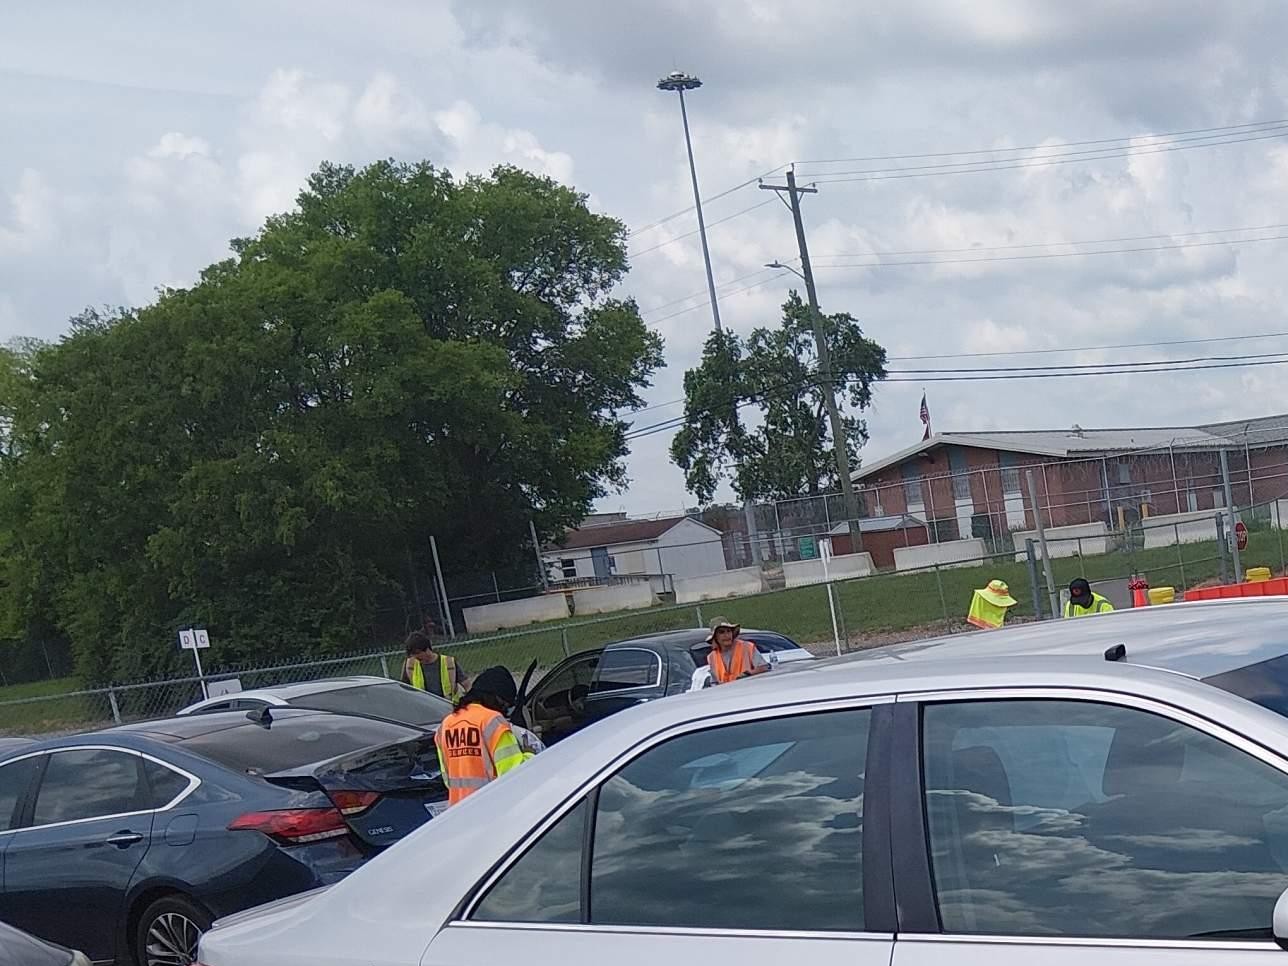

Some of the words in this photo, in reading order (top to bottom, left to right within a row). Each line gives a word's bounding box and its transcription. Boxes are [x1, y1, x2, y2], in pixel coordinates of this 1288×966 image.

[183, 635, 190, 645] D
[199, 634, 206, 644] C
[445, 727, 480, 749] MAD
[367, 826, 394, 836] GENESIS
